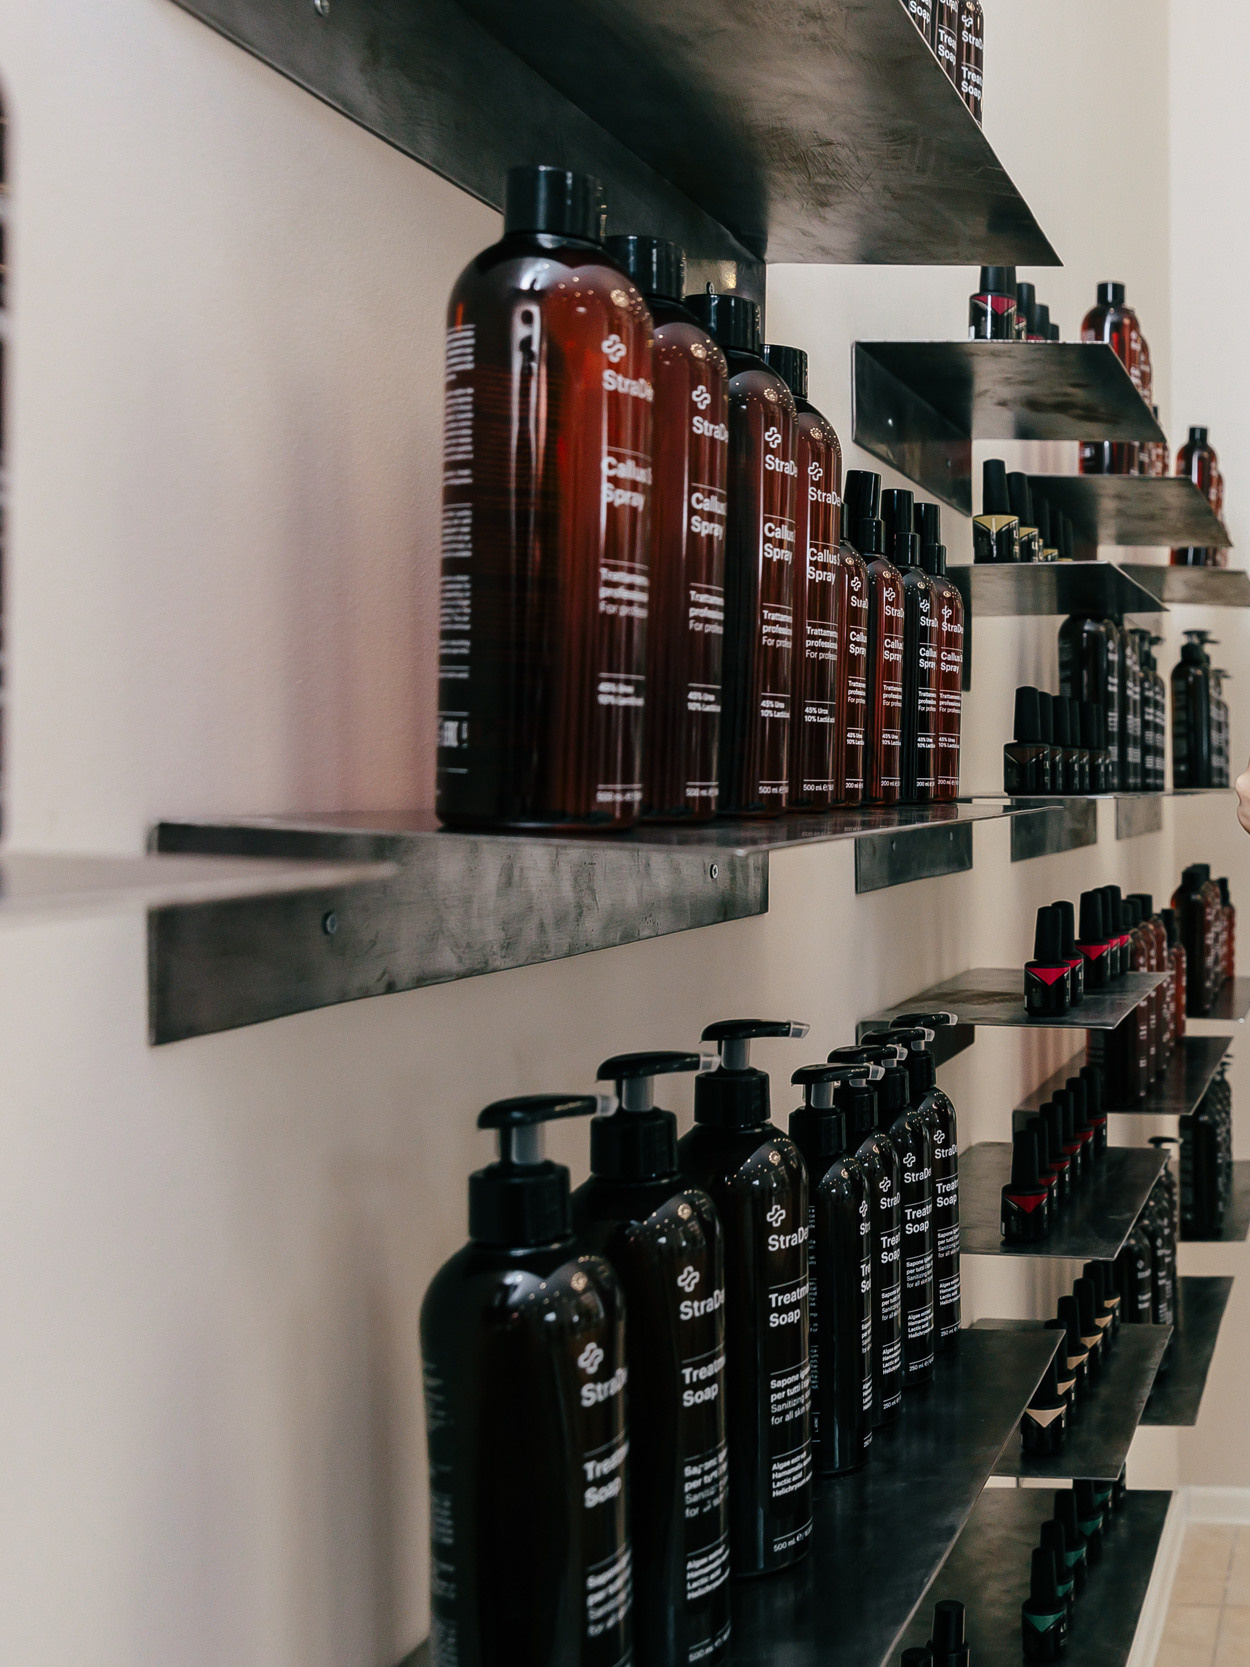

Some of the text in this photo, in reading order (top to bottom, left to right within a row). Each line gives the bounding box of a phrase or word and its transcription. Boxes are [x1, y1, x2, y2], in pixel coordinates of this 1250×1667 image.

[909, 1, 930, 24] Soap
[961, 81, 982, 101] Soap
[601, 483, 645, 512] Spray
[691, 516, 724, 540] Spray
[763, 543, 792, 565] Spray
[808, 566, 836, 586] Spray
[806, 649, 818, 659] For
[919, 658, 936, 670] Spray
[940, 662, 960, 674] Spray
[803, 783, 815, 792] 500
[936, 1194, 958, 1208] Soap
[905, 1220, 929, 1235] Soap
[881, 1248, 900, 1264] Soap
[769, 1308, 801, 1328] Soap
[770, 1373, 799, 1389] Sapone
[682, 1383, 719, 1408] Soap
[771, 1391, 786, 1403] per
[771, 1415, 784, 1425] for
[785, 1409, 794, 1422] all
[772, 1459, 790, 1471] Algae
[772, 1476, 792, 1489] Lactic
[773, 1541, 788, 1552] 500
